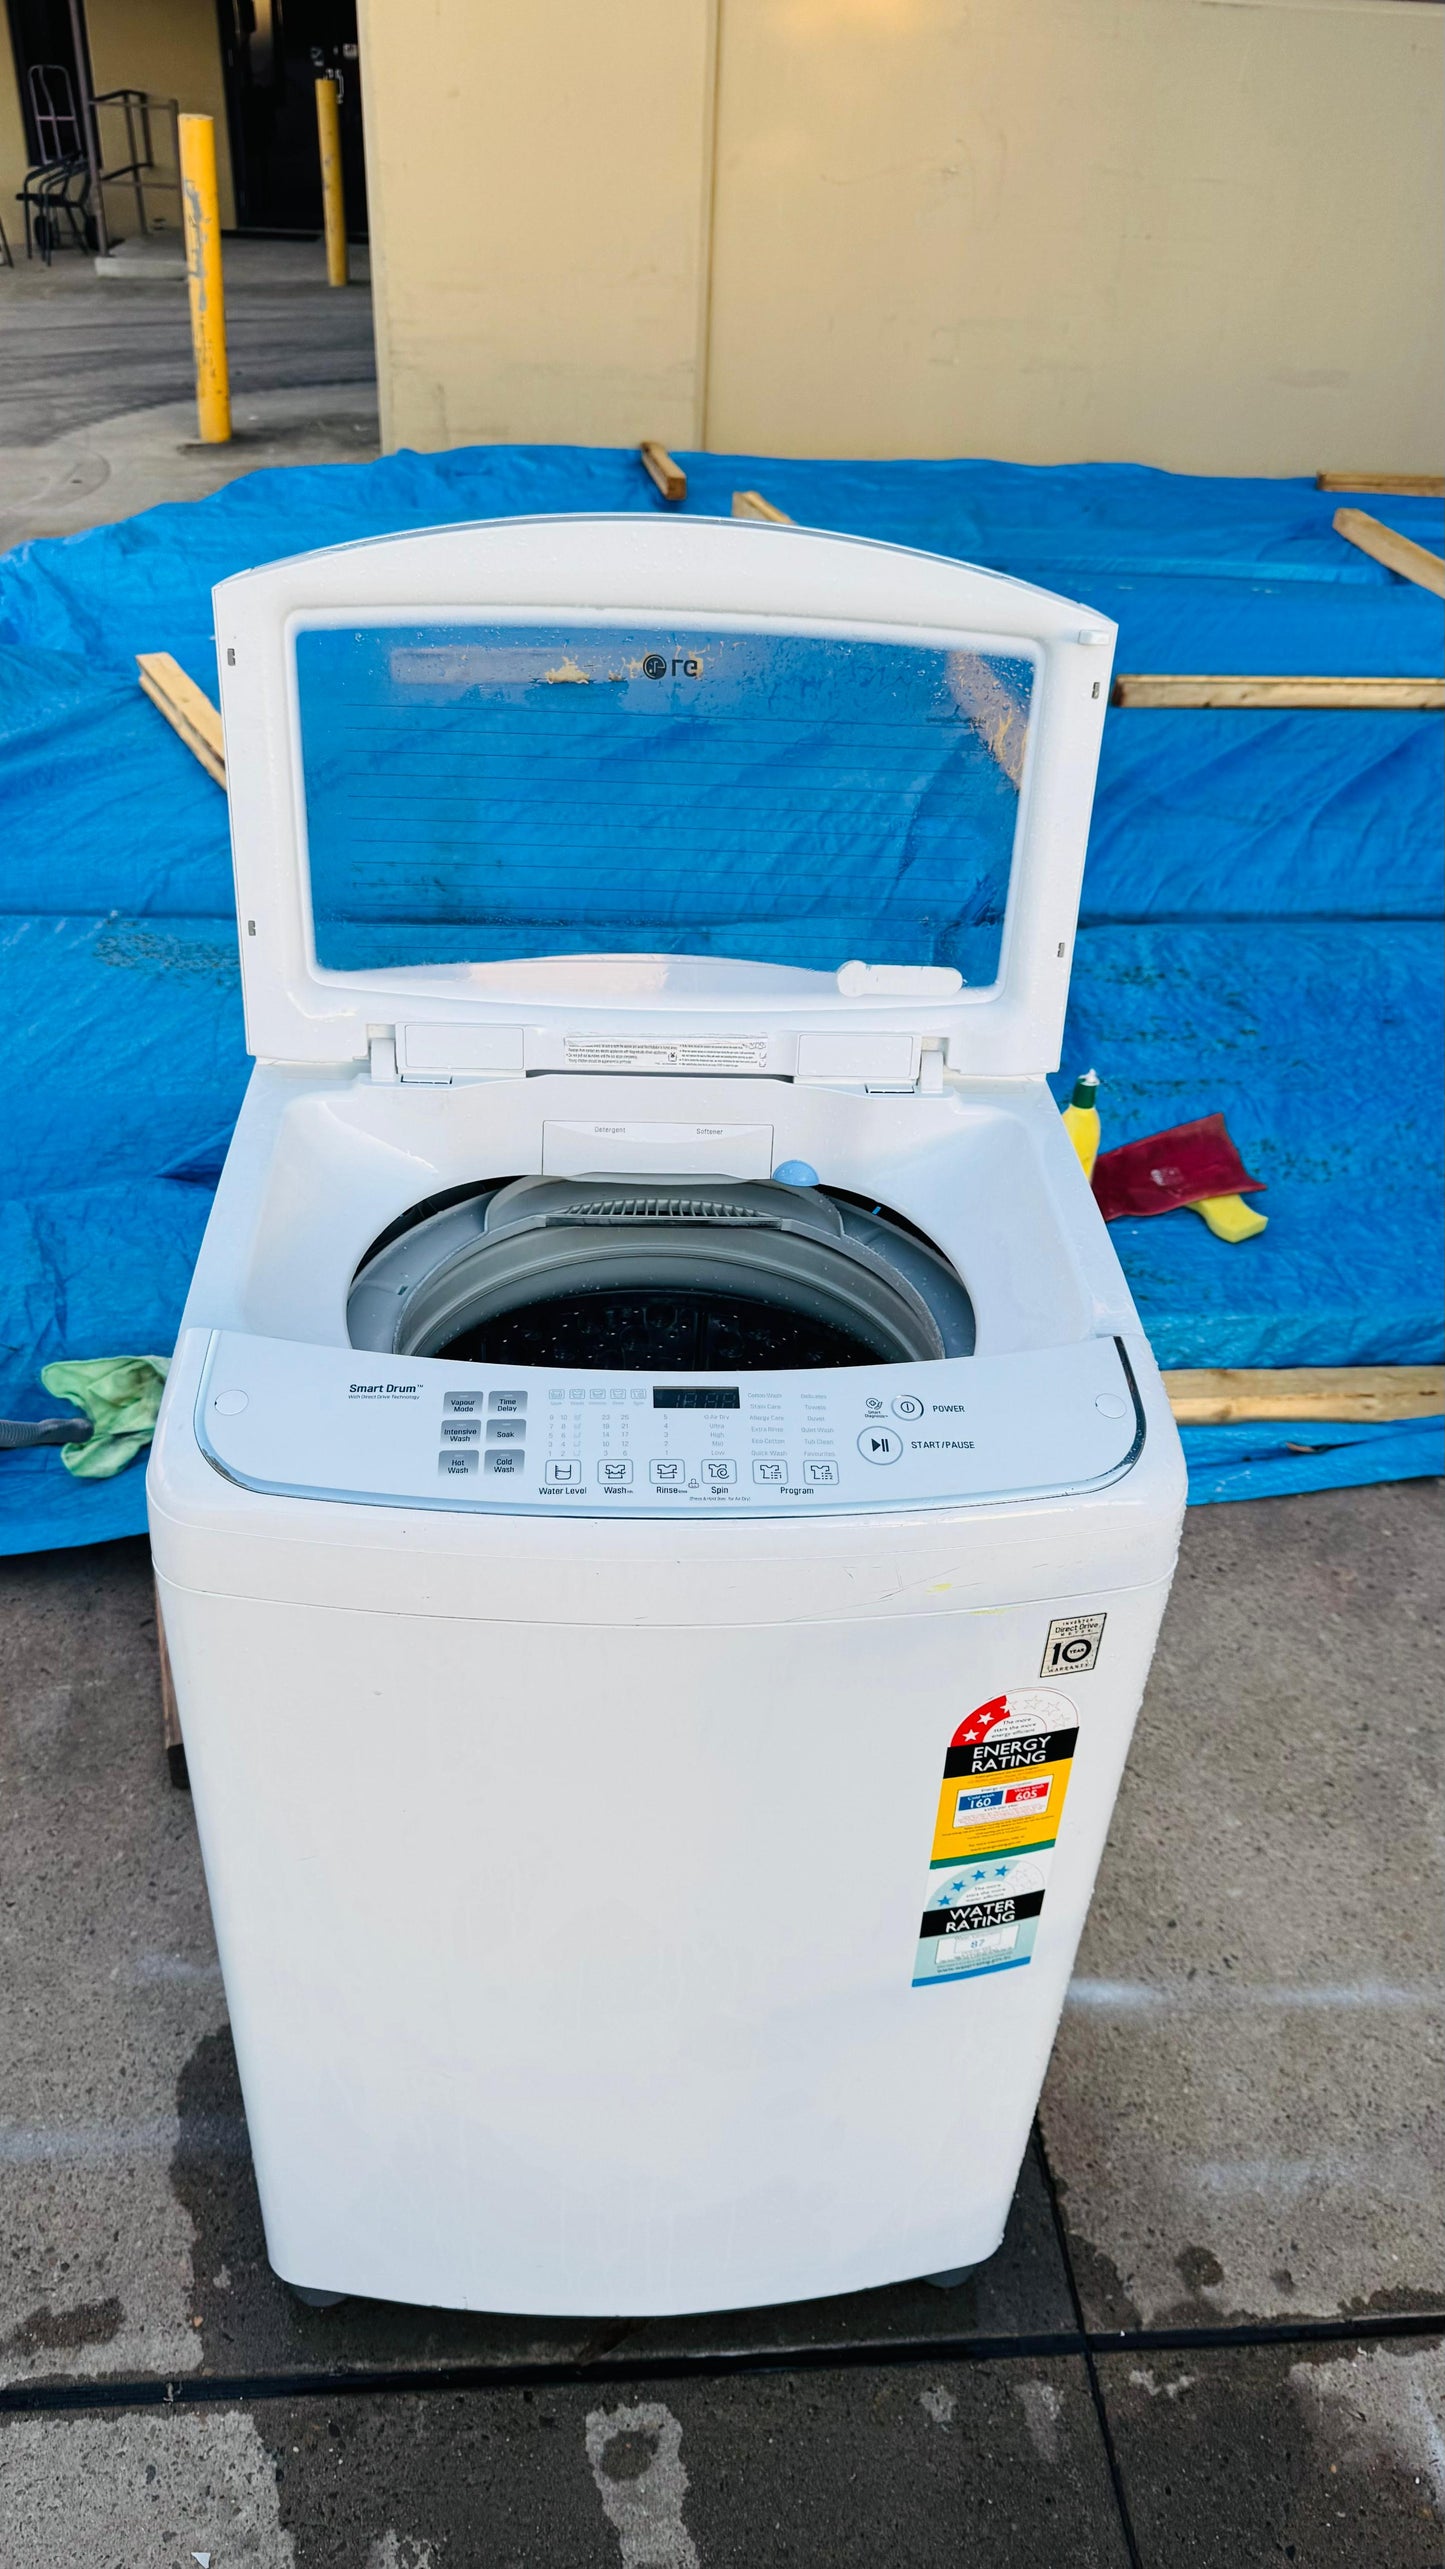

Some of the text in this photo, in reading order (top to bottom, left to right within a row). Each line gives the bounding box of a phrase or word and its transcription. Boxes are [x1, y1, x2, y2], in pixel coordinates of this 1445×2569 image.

[594, 1126, 626, 1134] Detergent
[349, 1384, 384, 1392] Smart
[911, 1441, 975, 1449] START/PAUSE
[604, 1486, 627, 1494] Wash
[656, 1486, 678, 1494] Rinse
[711, 1486, 728, 1495] Spin
[780, 1487, 814, 1496] Program
[1055, 1625, 1078, 1634] Direct
[1052, 1639, 1092, 1666] 10
[973, 1736, 1052, 1759] ENERGY
[971, 1751, 1047, 1773] RATING
[1015, 1789, 1038, 1801] 605
[970, 1798, 991, 1809] 160
[950, 1899, 1016, 1920] WATER
[946, 1911, 1015, 1933] RATING
